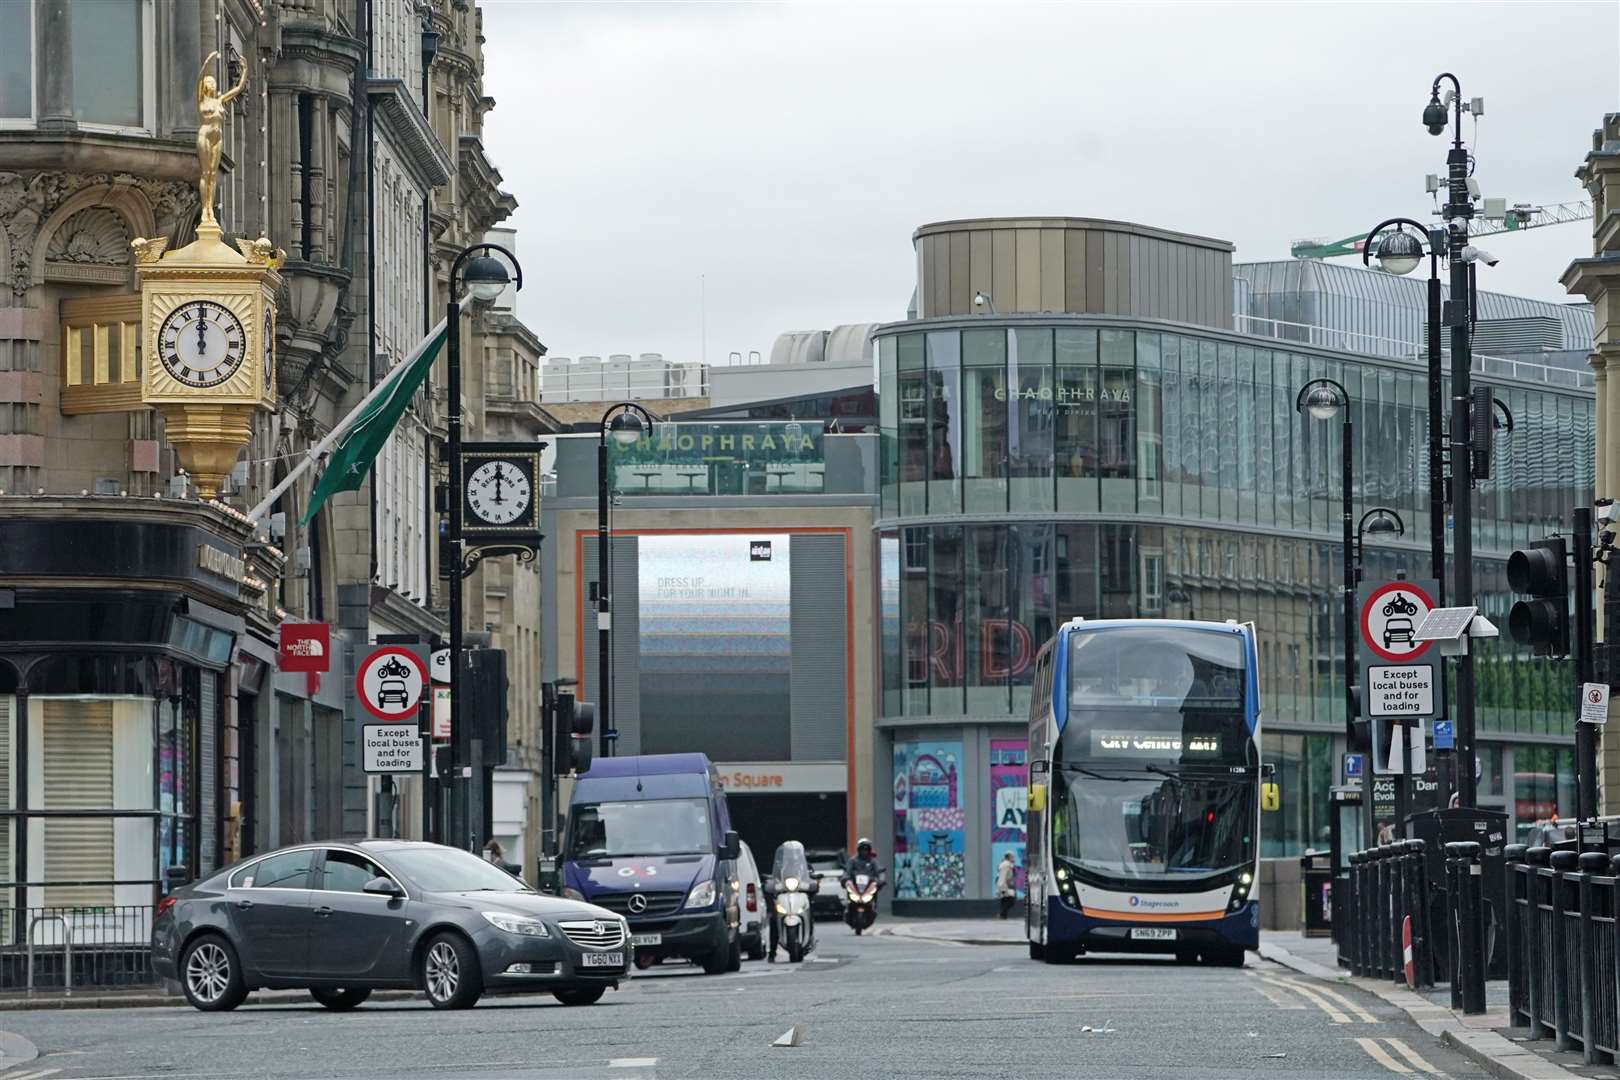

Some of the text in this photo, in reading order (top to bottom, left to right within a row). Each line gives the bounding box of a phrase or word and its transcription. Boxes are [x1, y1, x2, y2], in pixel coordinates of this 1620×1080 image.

[1383, 670, 1418, 680] Except
[1373, 681, 1429, 690] local buses
[1383, 691, 1419, 700] and for
[1383, 702, 1420, 712] loading
[377, 729, 409, 738] Except
[367, 739, 420, 747] local buses
[377, 749, 410, 757] and for
[376, 759, 411, 768] loading
[735, 773, 783, 789] Square
[1140, 900, 1180, 908] Stagecoach
